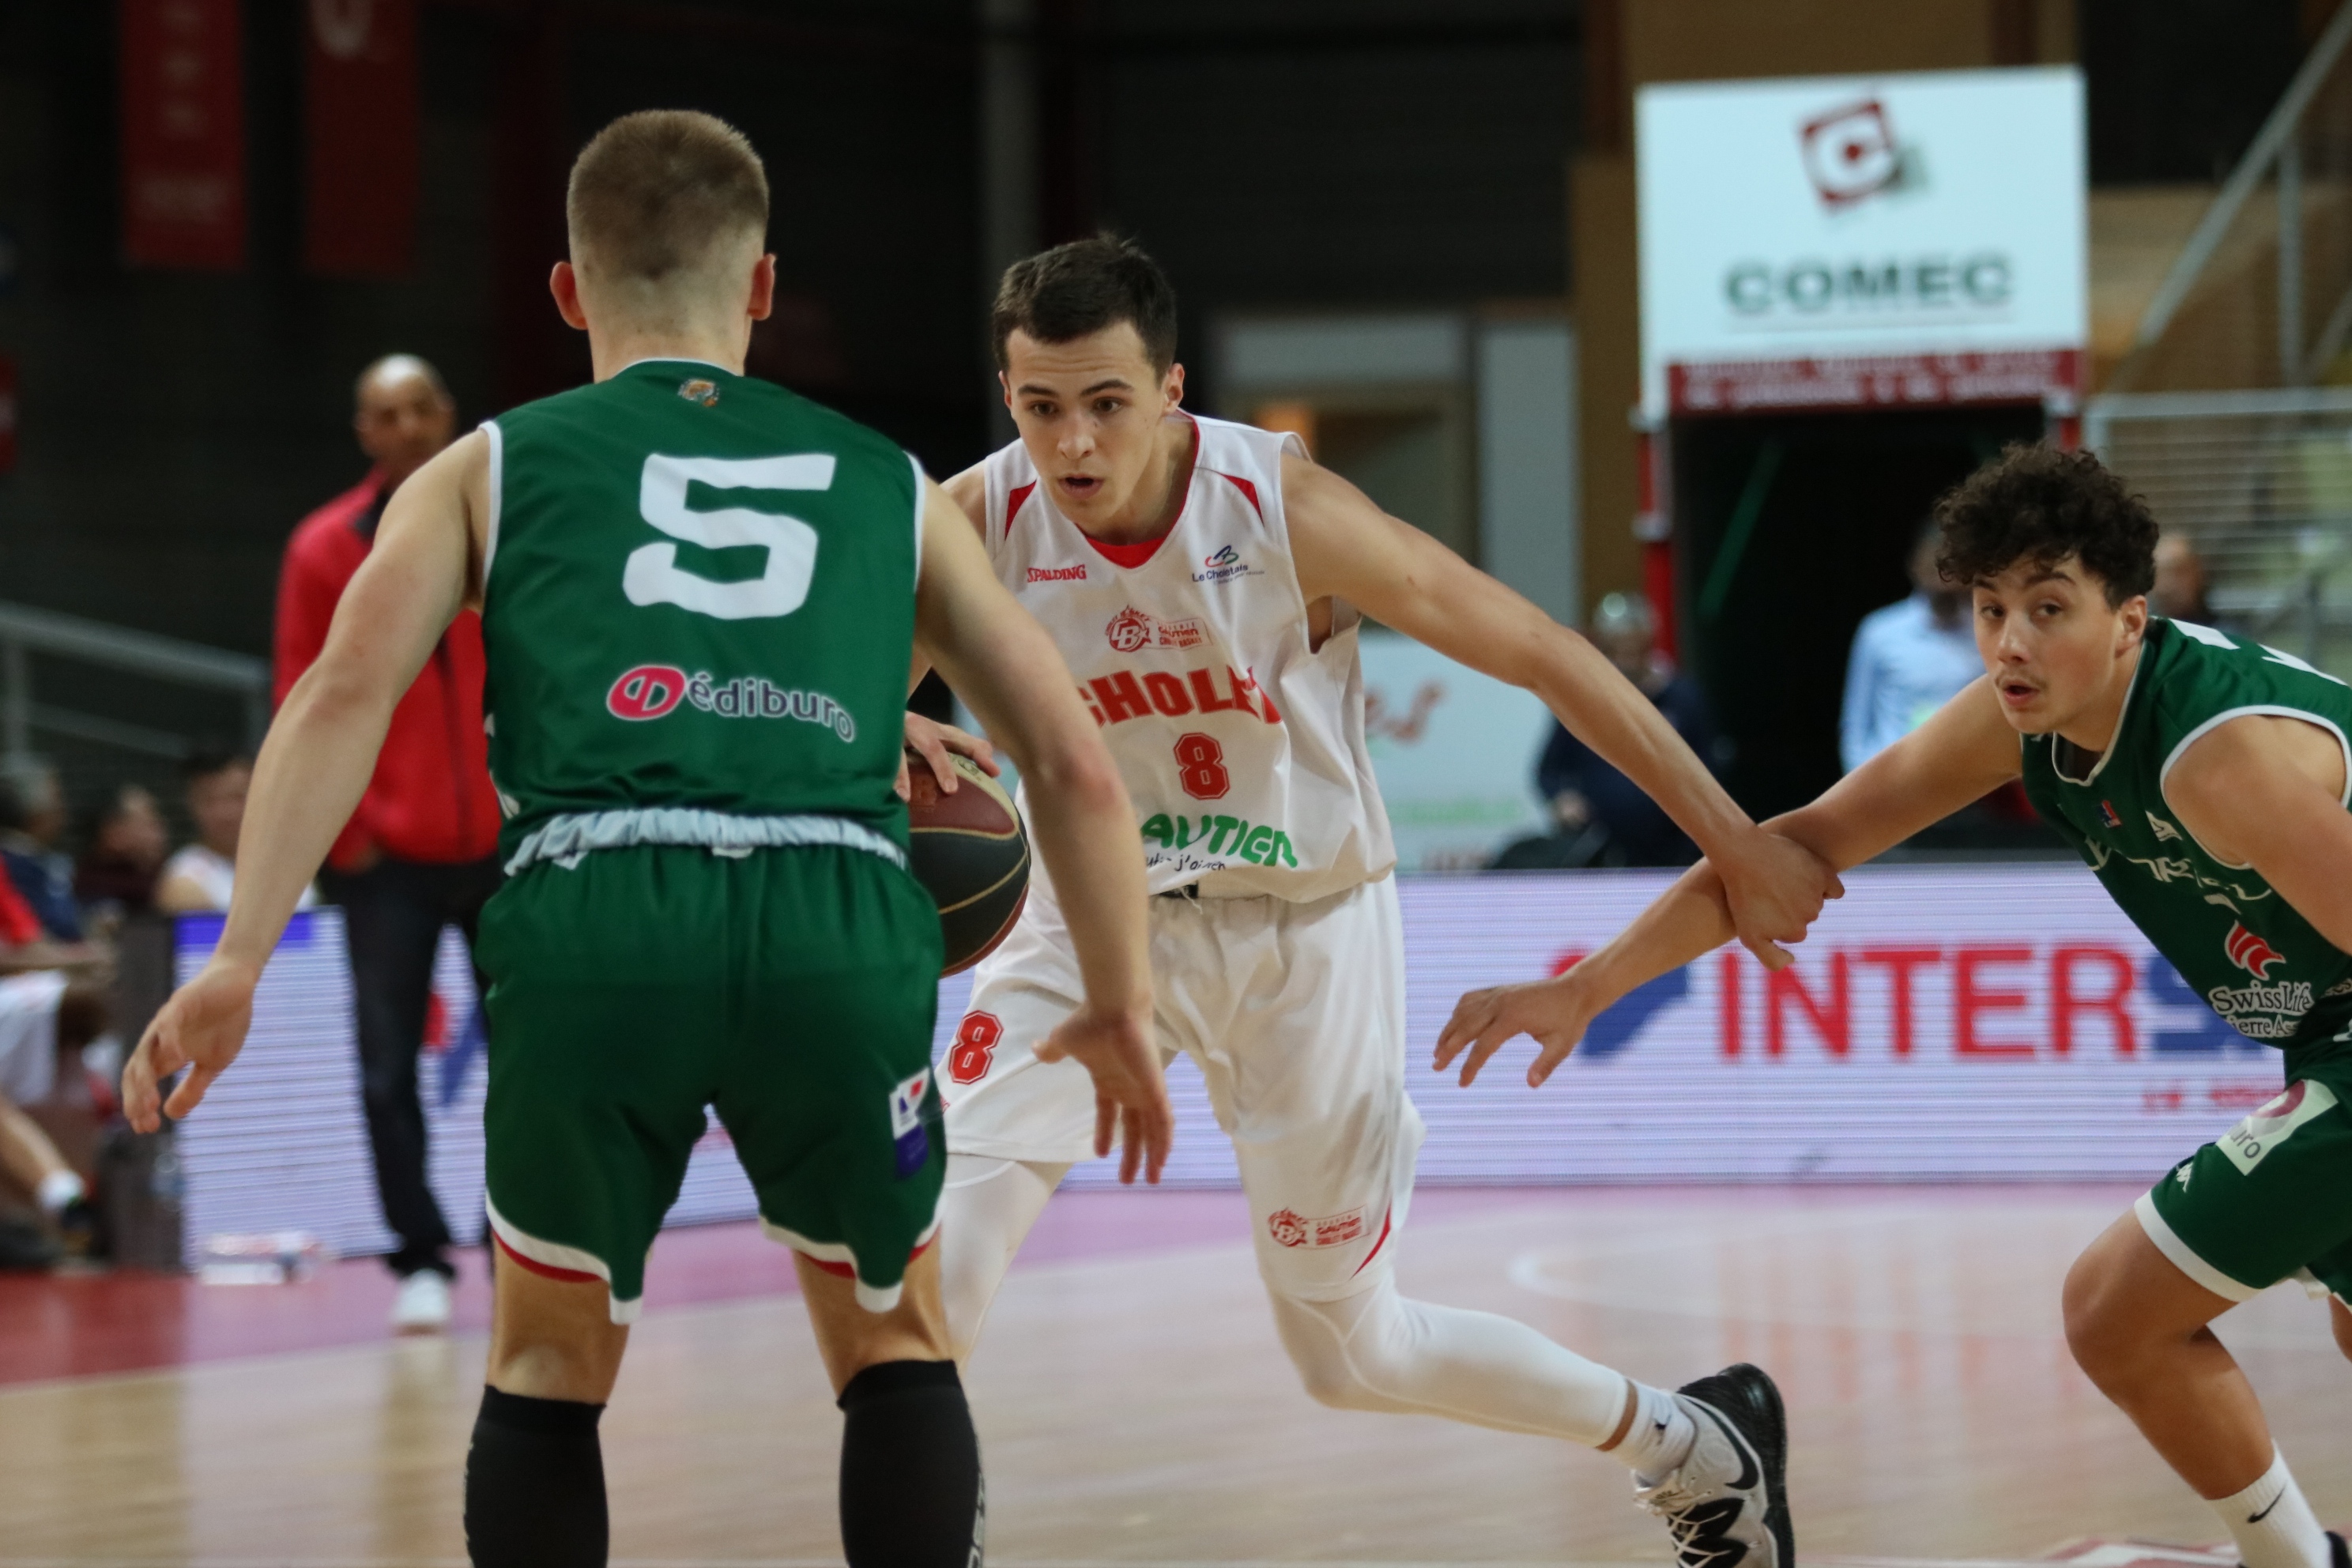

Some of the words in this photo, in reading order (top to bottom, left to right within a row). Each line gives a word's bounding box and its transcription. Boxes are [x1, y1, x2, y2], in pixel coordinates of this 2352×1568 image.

[1724, 255, 2014, 316] COMEC
[623, 453, 836, 620] 5
[1027, 564, 1087, 582] SPALDING
[1192, 572, 1205, 582] Le
[1206, 564, 1249, 580] Choletais
[685, 671, 856, 743] édiburo
[1076, 665, 1283, 728] HOL
[1173, 732, 1231, 801] 8
[1140, 813, 1298, 869] AUTIER
[1721, 942, 2267, 1058] INTERS
[2211, 982, 2312, 1013] SwissLife
[2230, 1018, 2271, 1036] ierre
[949, 1009, 1004, 1085] 8
[2228, 1129, 2262, 1159] uro
